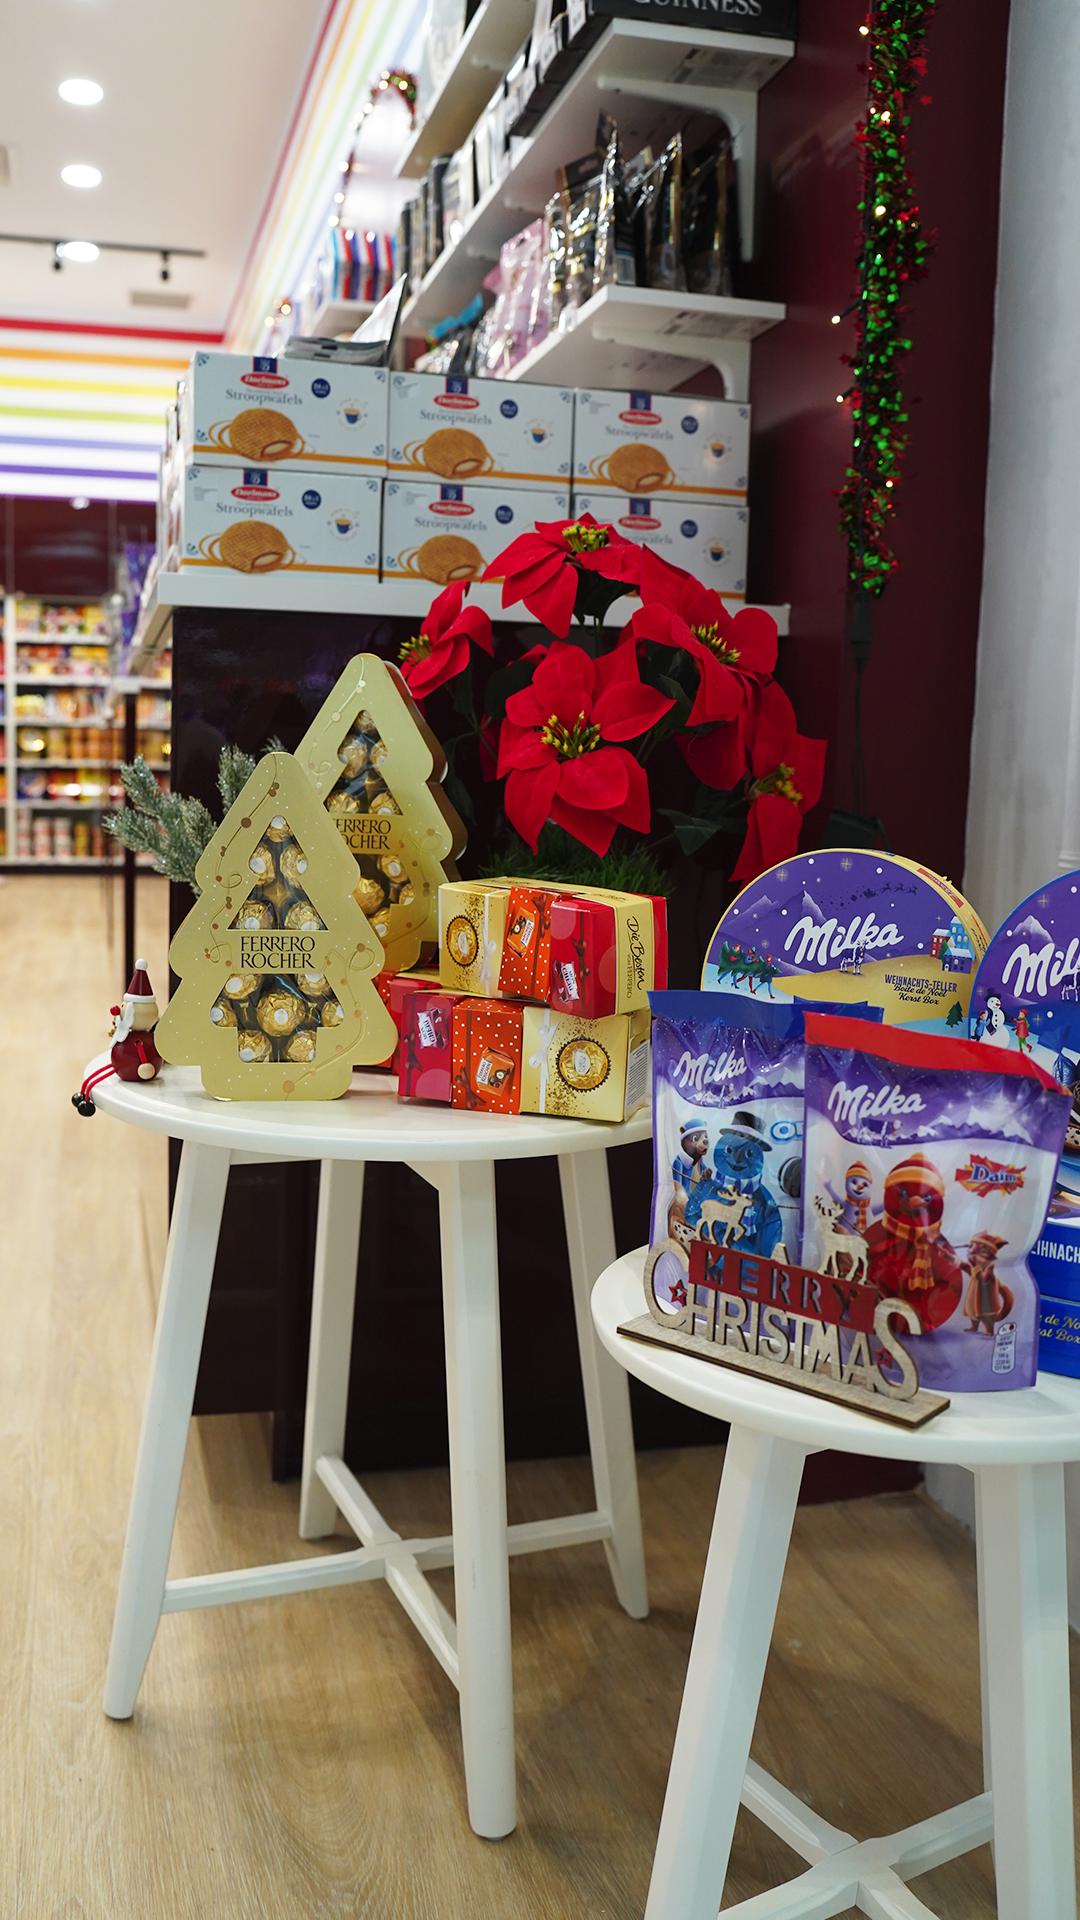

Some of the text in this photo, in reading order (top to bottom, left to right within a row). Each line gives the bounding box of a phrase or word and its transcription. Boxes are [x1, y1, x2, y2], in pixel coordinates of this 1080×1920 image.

[634, 0, 762, 16] NESS
[225, 388, 303, 405] Stroopwafels
[215, 503, 294, 517] Stroopwafels
[333, 818, 392, 835] ERRERO
[341, 833, 391, 850] OCHER
[240, 935, 316, 952] FERRERO
[784, 912, 905, 966] Milka
[240, 952, 315, 969] ROCHER
[626, 915, 646, 991] Die Besten
[1001, 937, 1080, 998] Mil
[884, 973, 958, 993] WEIHNACHTS-TELLER
[922, 995, 940, 1005] Box
[672, 1048, 748, 1090] Milka
[827, 1081, 927, 1124] Milka
[970, 1162, 1016, 1184] Daim
[1031, 1240, 1080, 1264] IHNACH
[703, 1248, 859, 1322] MERRY
[643, 1236, 923, 1400] CHRISTMAS
[1062, 1315, 1080, 1330] No
